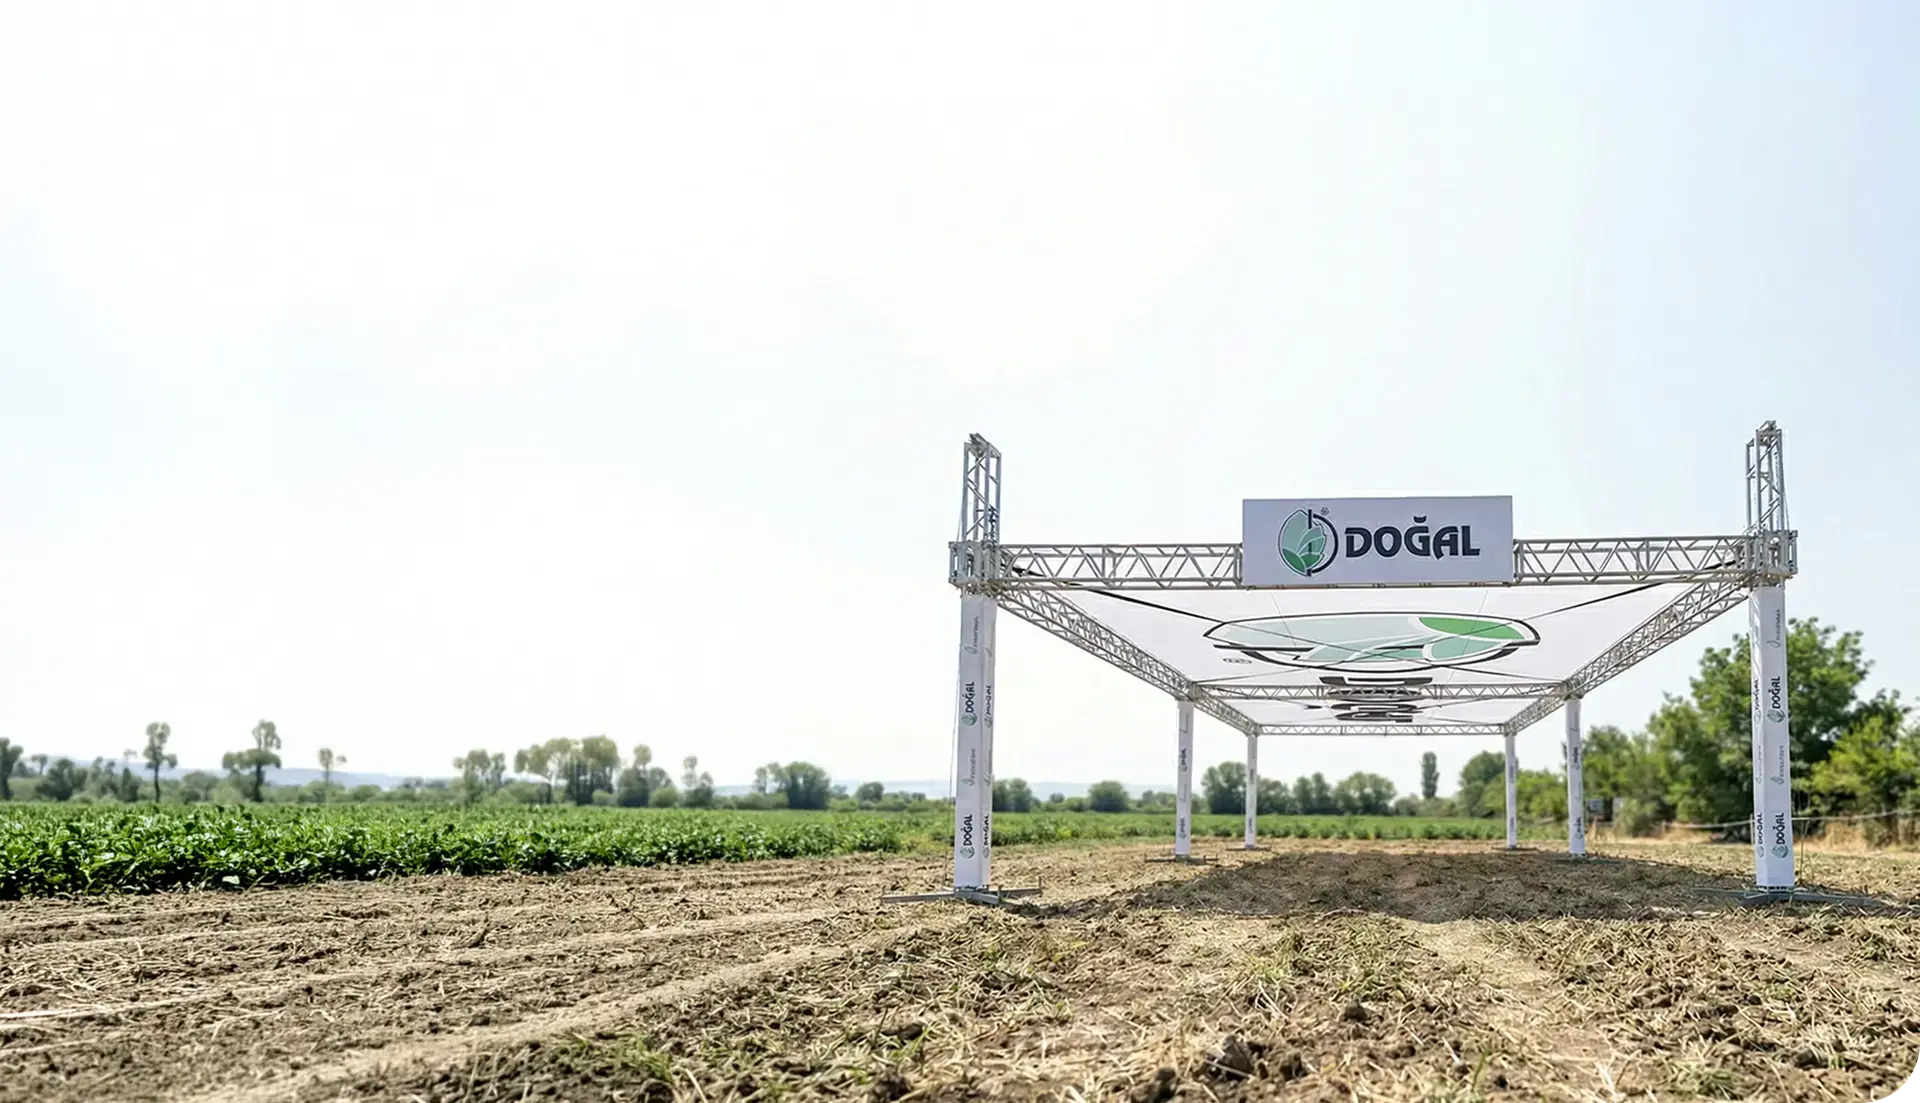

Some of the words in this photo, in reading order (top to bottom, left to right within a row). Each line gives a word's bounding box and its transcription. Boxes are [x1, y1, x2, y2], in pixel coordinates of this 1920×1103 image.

[1344, 515, 1481, 560] DOĞAL
[962, 681, 975, 713] DOĞAL
[1768, 676, 1781, 709] DOĞAL
[960, 814, 973, 846] DOĞAL
[1772, 812, 1785, 845] DOĞAL
